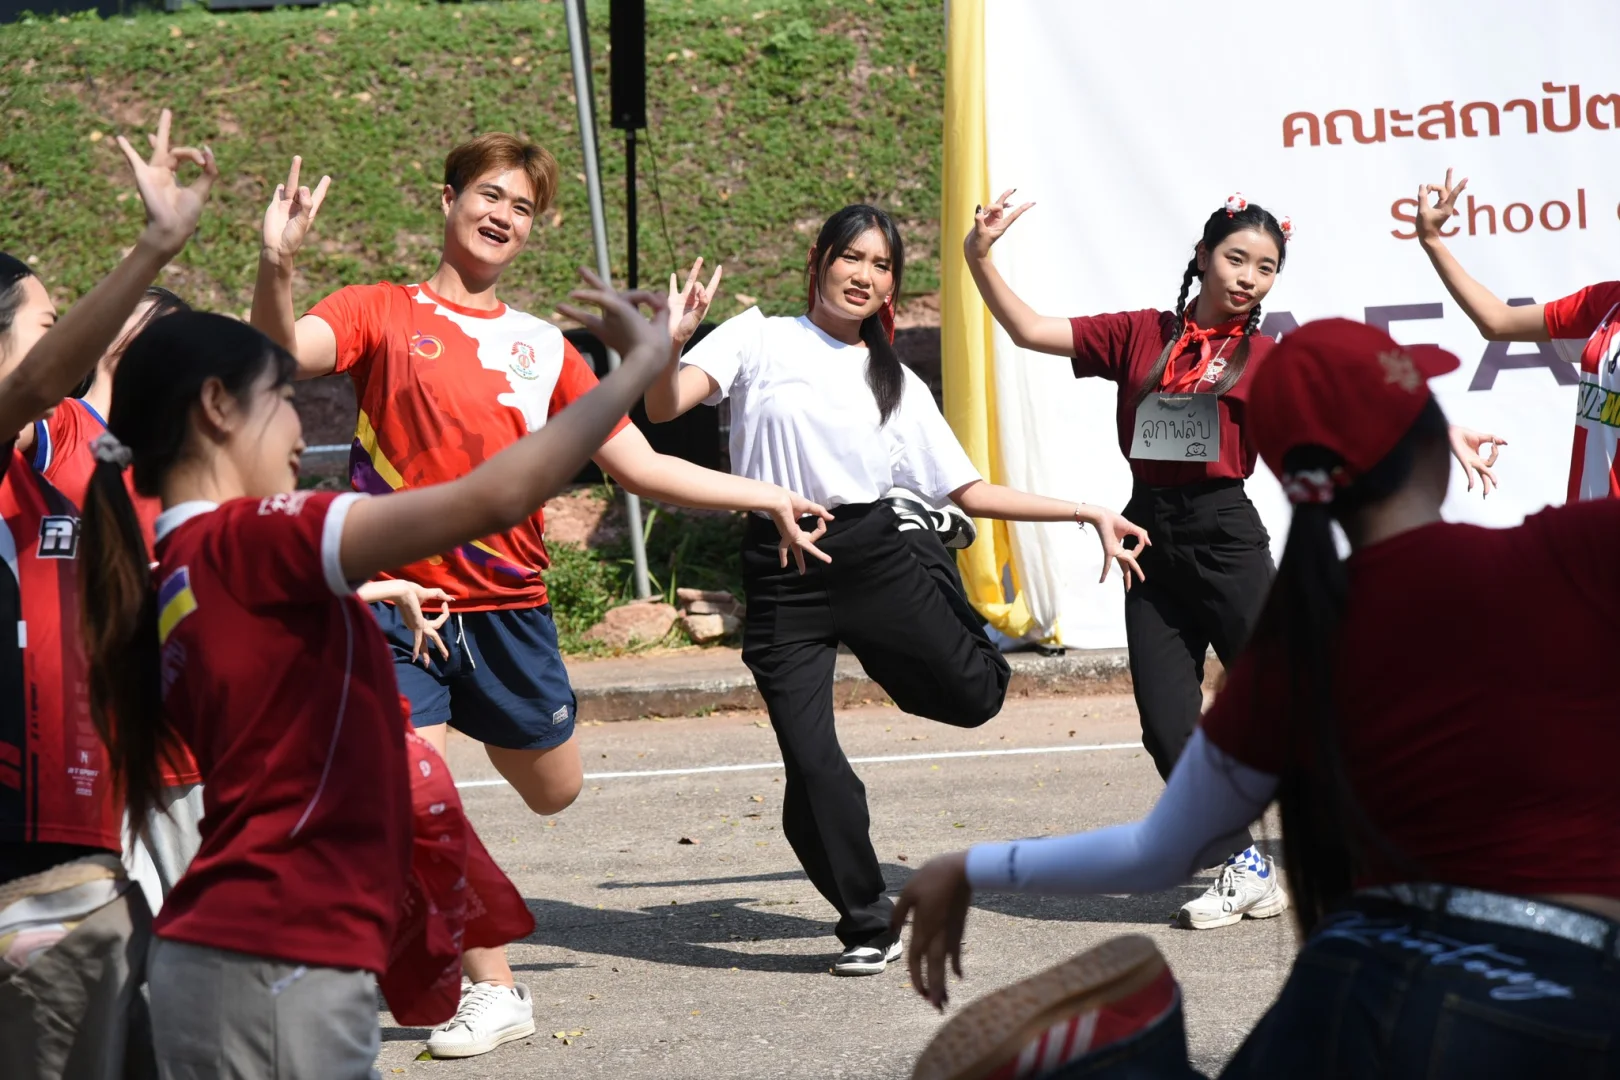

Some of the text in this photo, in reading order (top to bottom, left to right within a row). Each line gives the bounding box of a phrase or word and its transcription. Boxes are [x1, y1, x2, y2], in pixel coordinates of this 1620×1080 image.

[1282, 81, 1620, 148] คณะสถาปัต
[1141, 411, 1212, 448] ลูกพลับ
